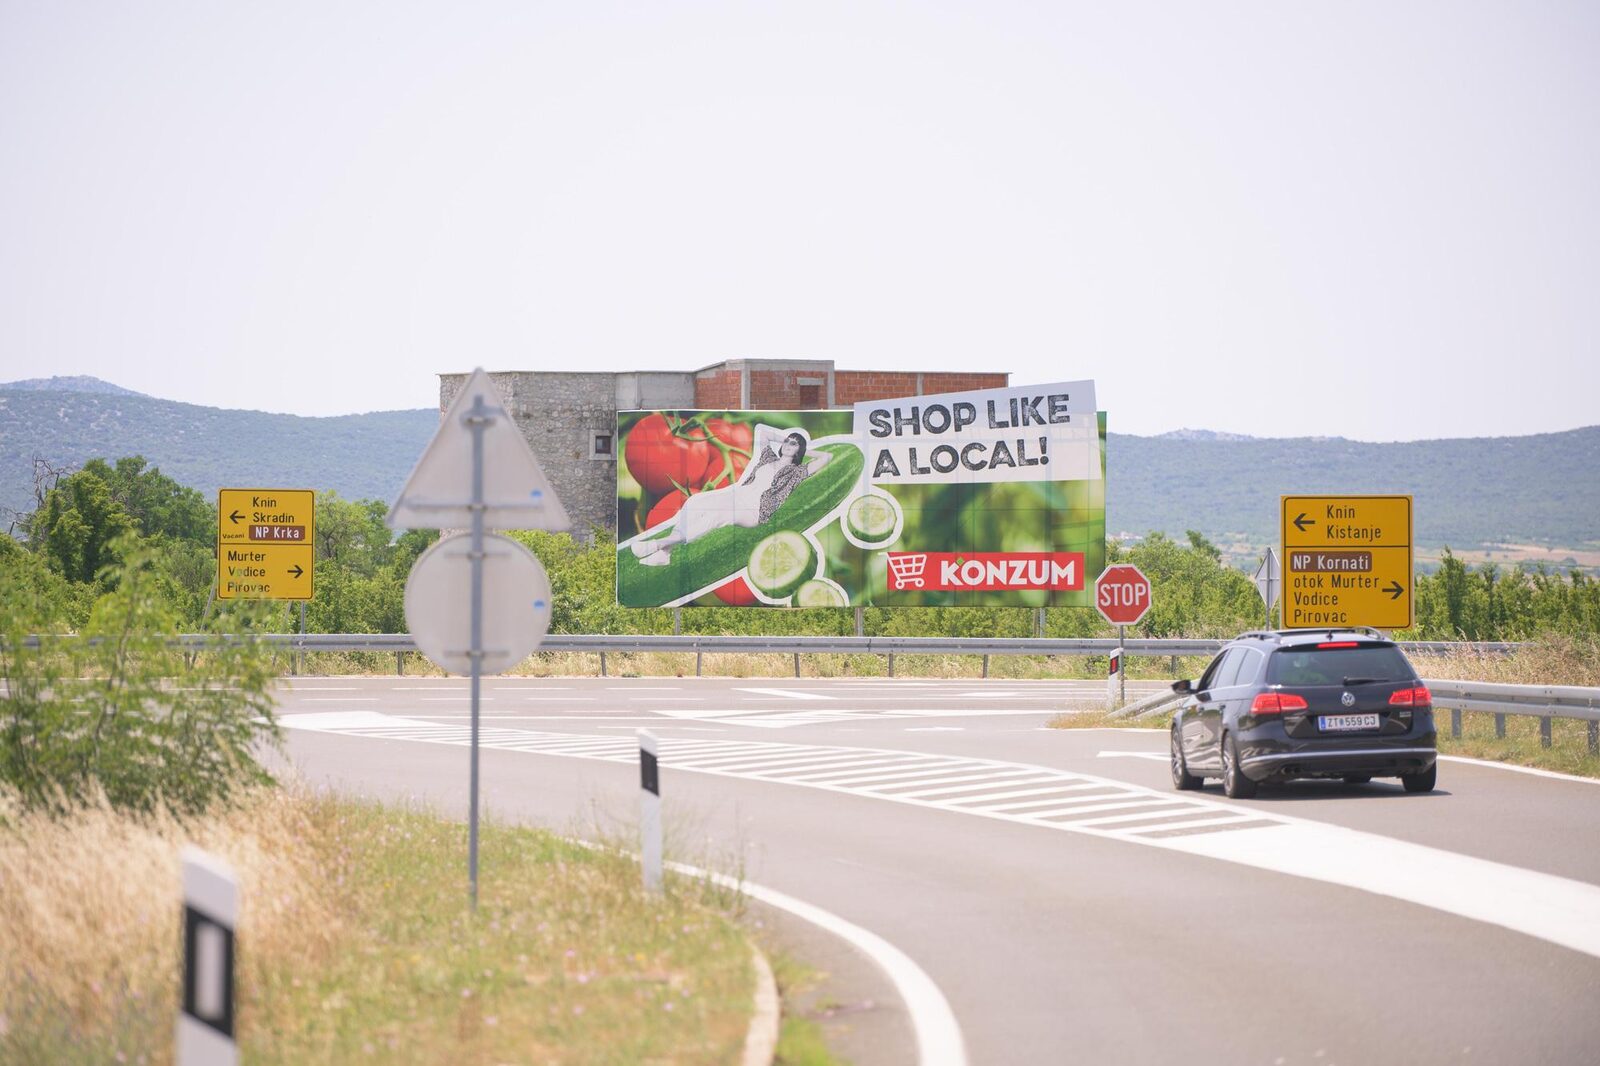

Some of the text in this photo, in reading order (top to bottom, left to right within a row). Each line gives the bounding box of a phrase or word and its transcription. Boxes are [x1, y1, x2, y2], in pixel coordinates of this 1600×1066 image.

[869, 394, 1071, 438] SHOP LIKE
[872, 436, 1049, 478] A LOCAL!
[252, 496, 277, 508] Knin
[253, 512, 295, 523] Skradin
[1326, 504, 1356, 519] Knin
[255, 526, 300, 539] NP Krka
[1326, 525, 1382, 542] Kistanje
[227, 551, 267, 562] Murter
[1293, 555, 1369, 570] NP Kornati
[940, 559, 1075, 586] KONZUM
[1293, 574, 1380, 589] otok Murter
[1100, 582, 1147, 607] STOP
[1293, 592, 1339, 606] Vodice
[1294, 609, 1348, 624] Pirovac
